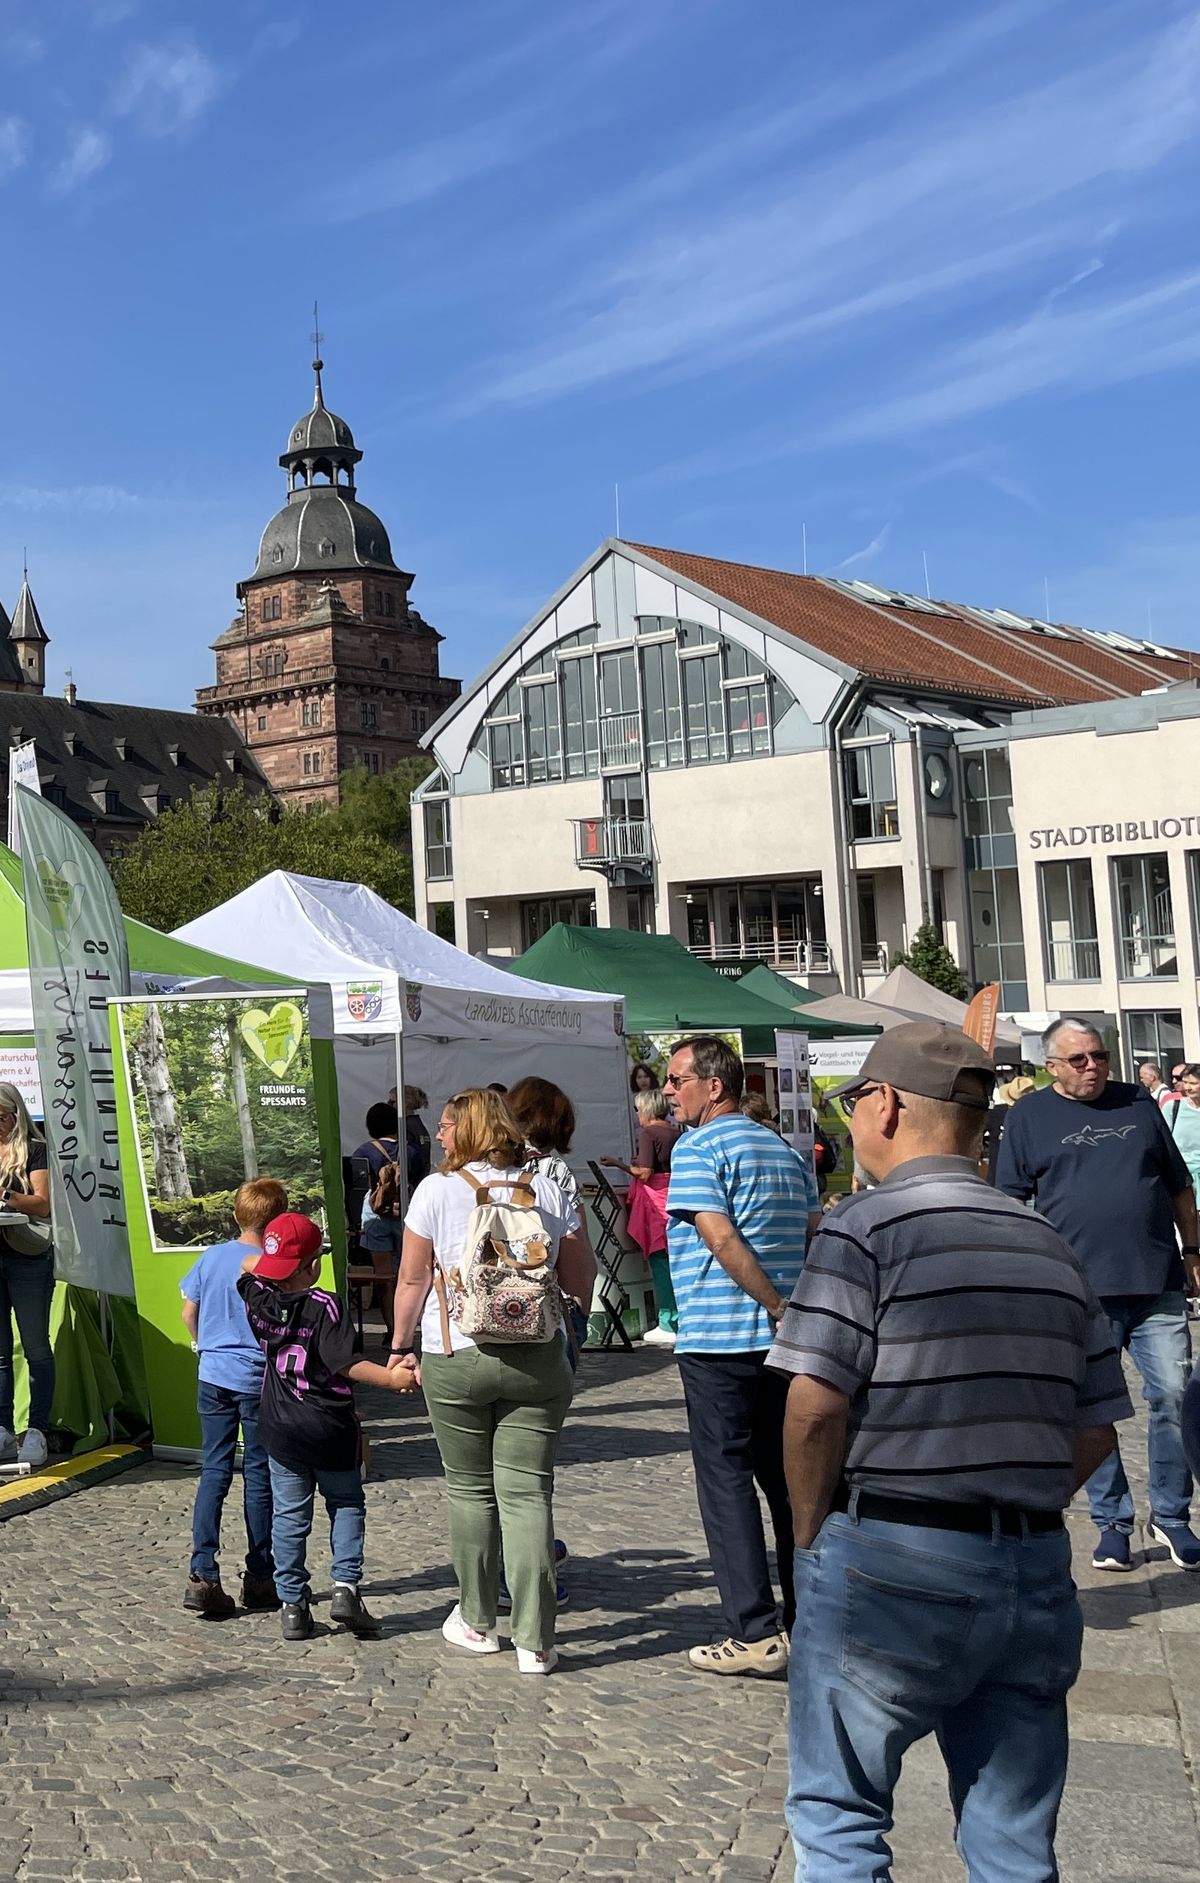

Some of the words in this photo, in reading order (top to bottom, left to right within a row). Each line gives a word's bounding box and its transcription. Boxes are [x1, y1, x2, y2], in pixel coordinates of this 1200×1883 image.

[464, 997, 515, 1024] Landkreis
[519, 1001, 582, 1034] Aschaffenburg
[17, 1067, 33, 1075] e.V.
[260, 1085, 296, 1094] FREUNDE
[260, 1097, 307, 1106] SPESSARTS
